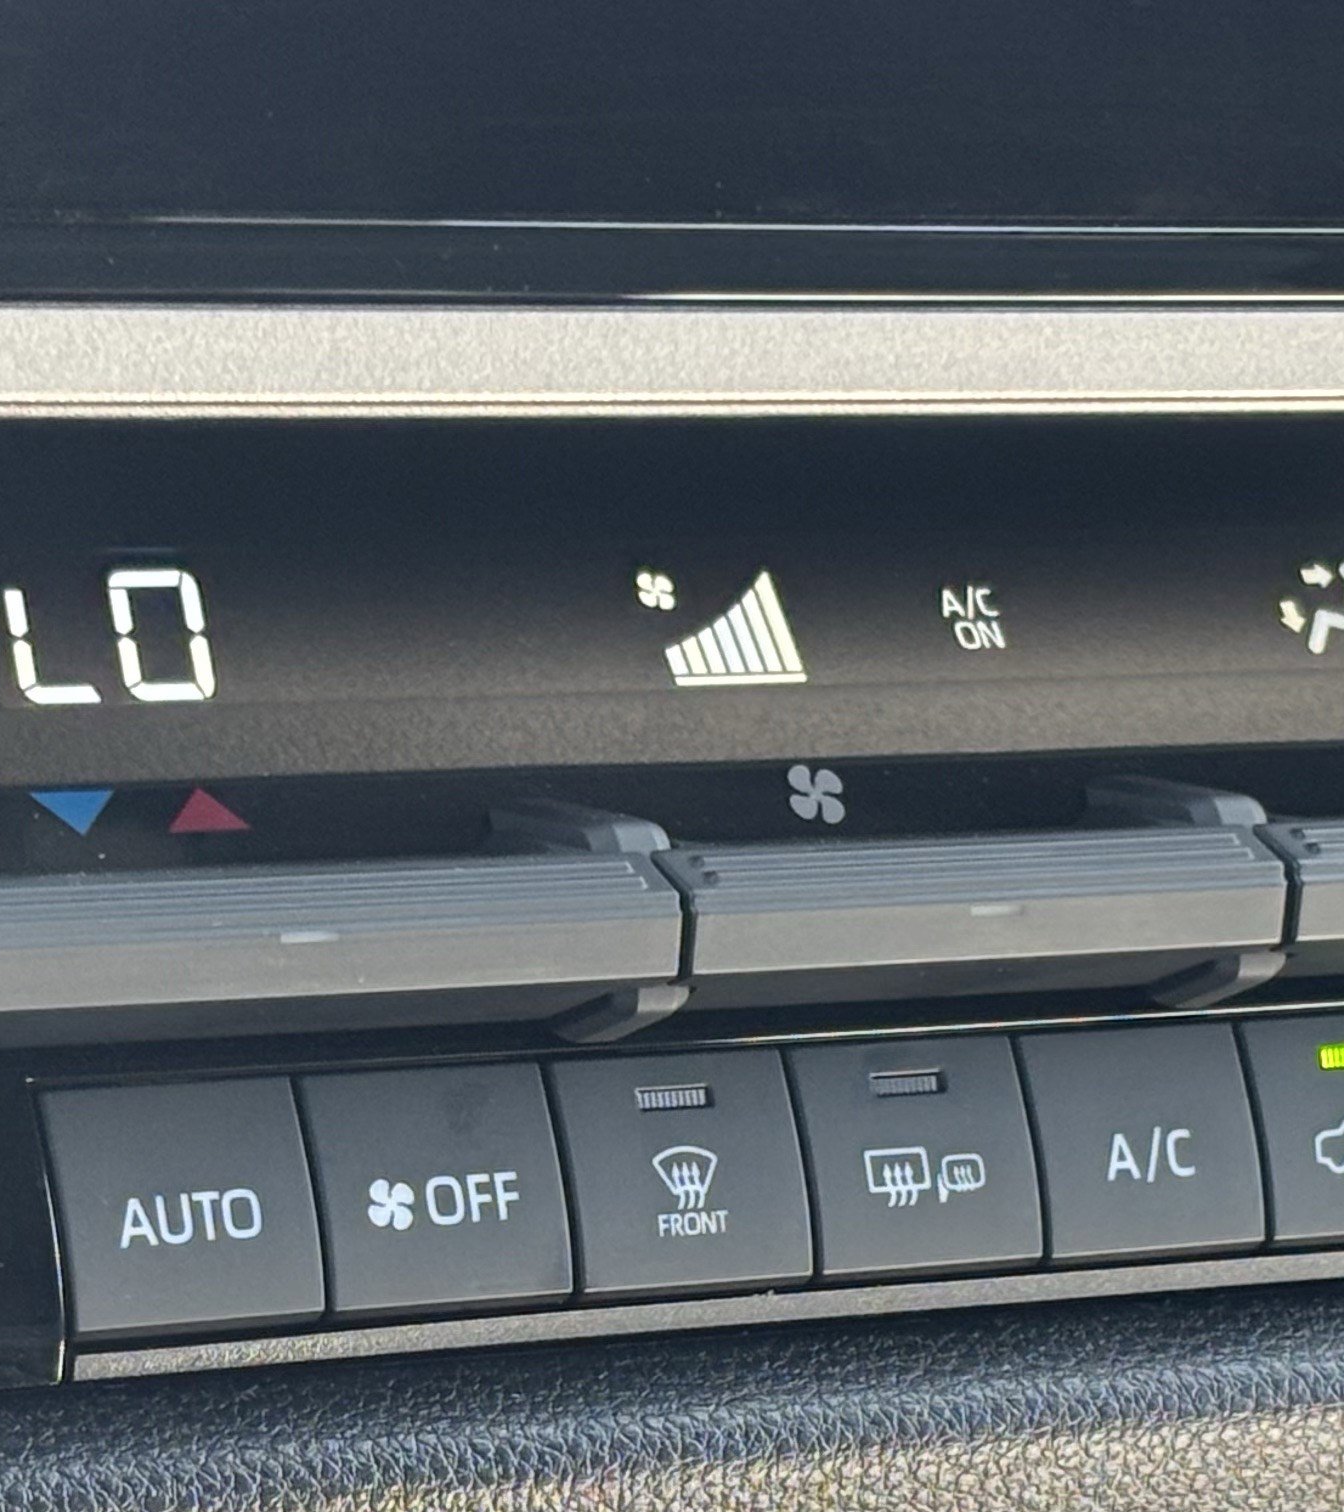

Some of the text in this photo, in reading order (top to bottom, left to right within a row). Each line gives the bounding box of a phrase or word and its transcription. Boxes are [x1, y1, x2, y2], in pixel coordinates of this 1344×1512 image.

[940, 584, 1001, 621] A/C
[0, 567, 218, 706] LO
[954, 620, 1007, 651] ON
[1107, 1125, 1197, 1184] A/C
[119, 1187, 263, 1250] AUTO
[425, 1170, 521, 1227] OFF
[657, 1209, 729, 1238] FRONT
